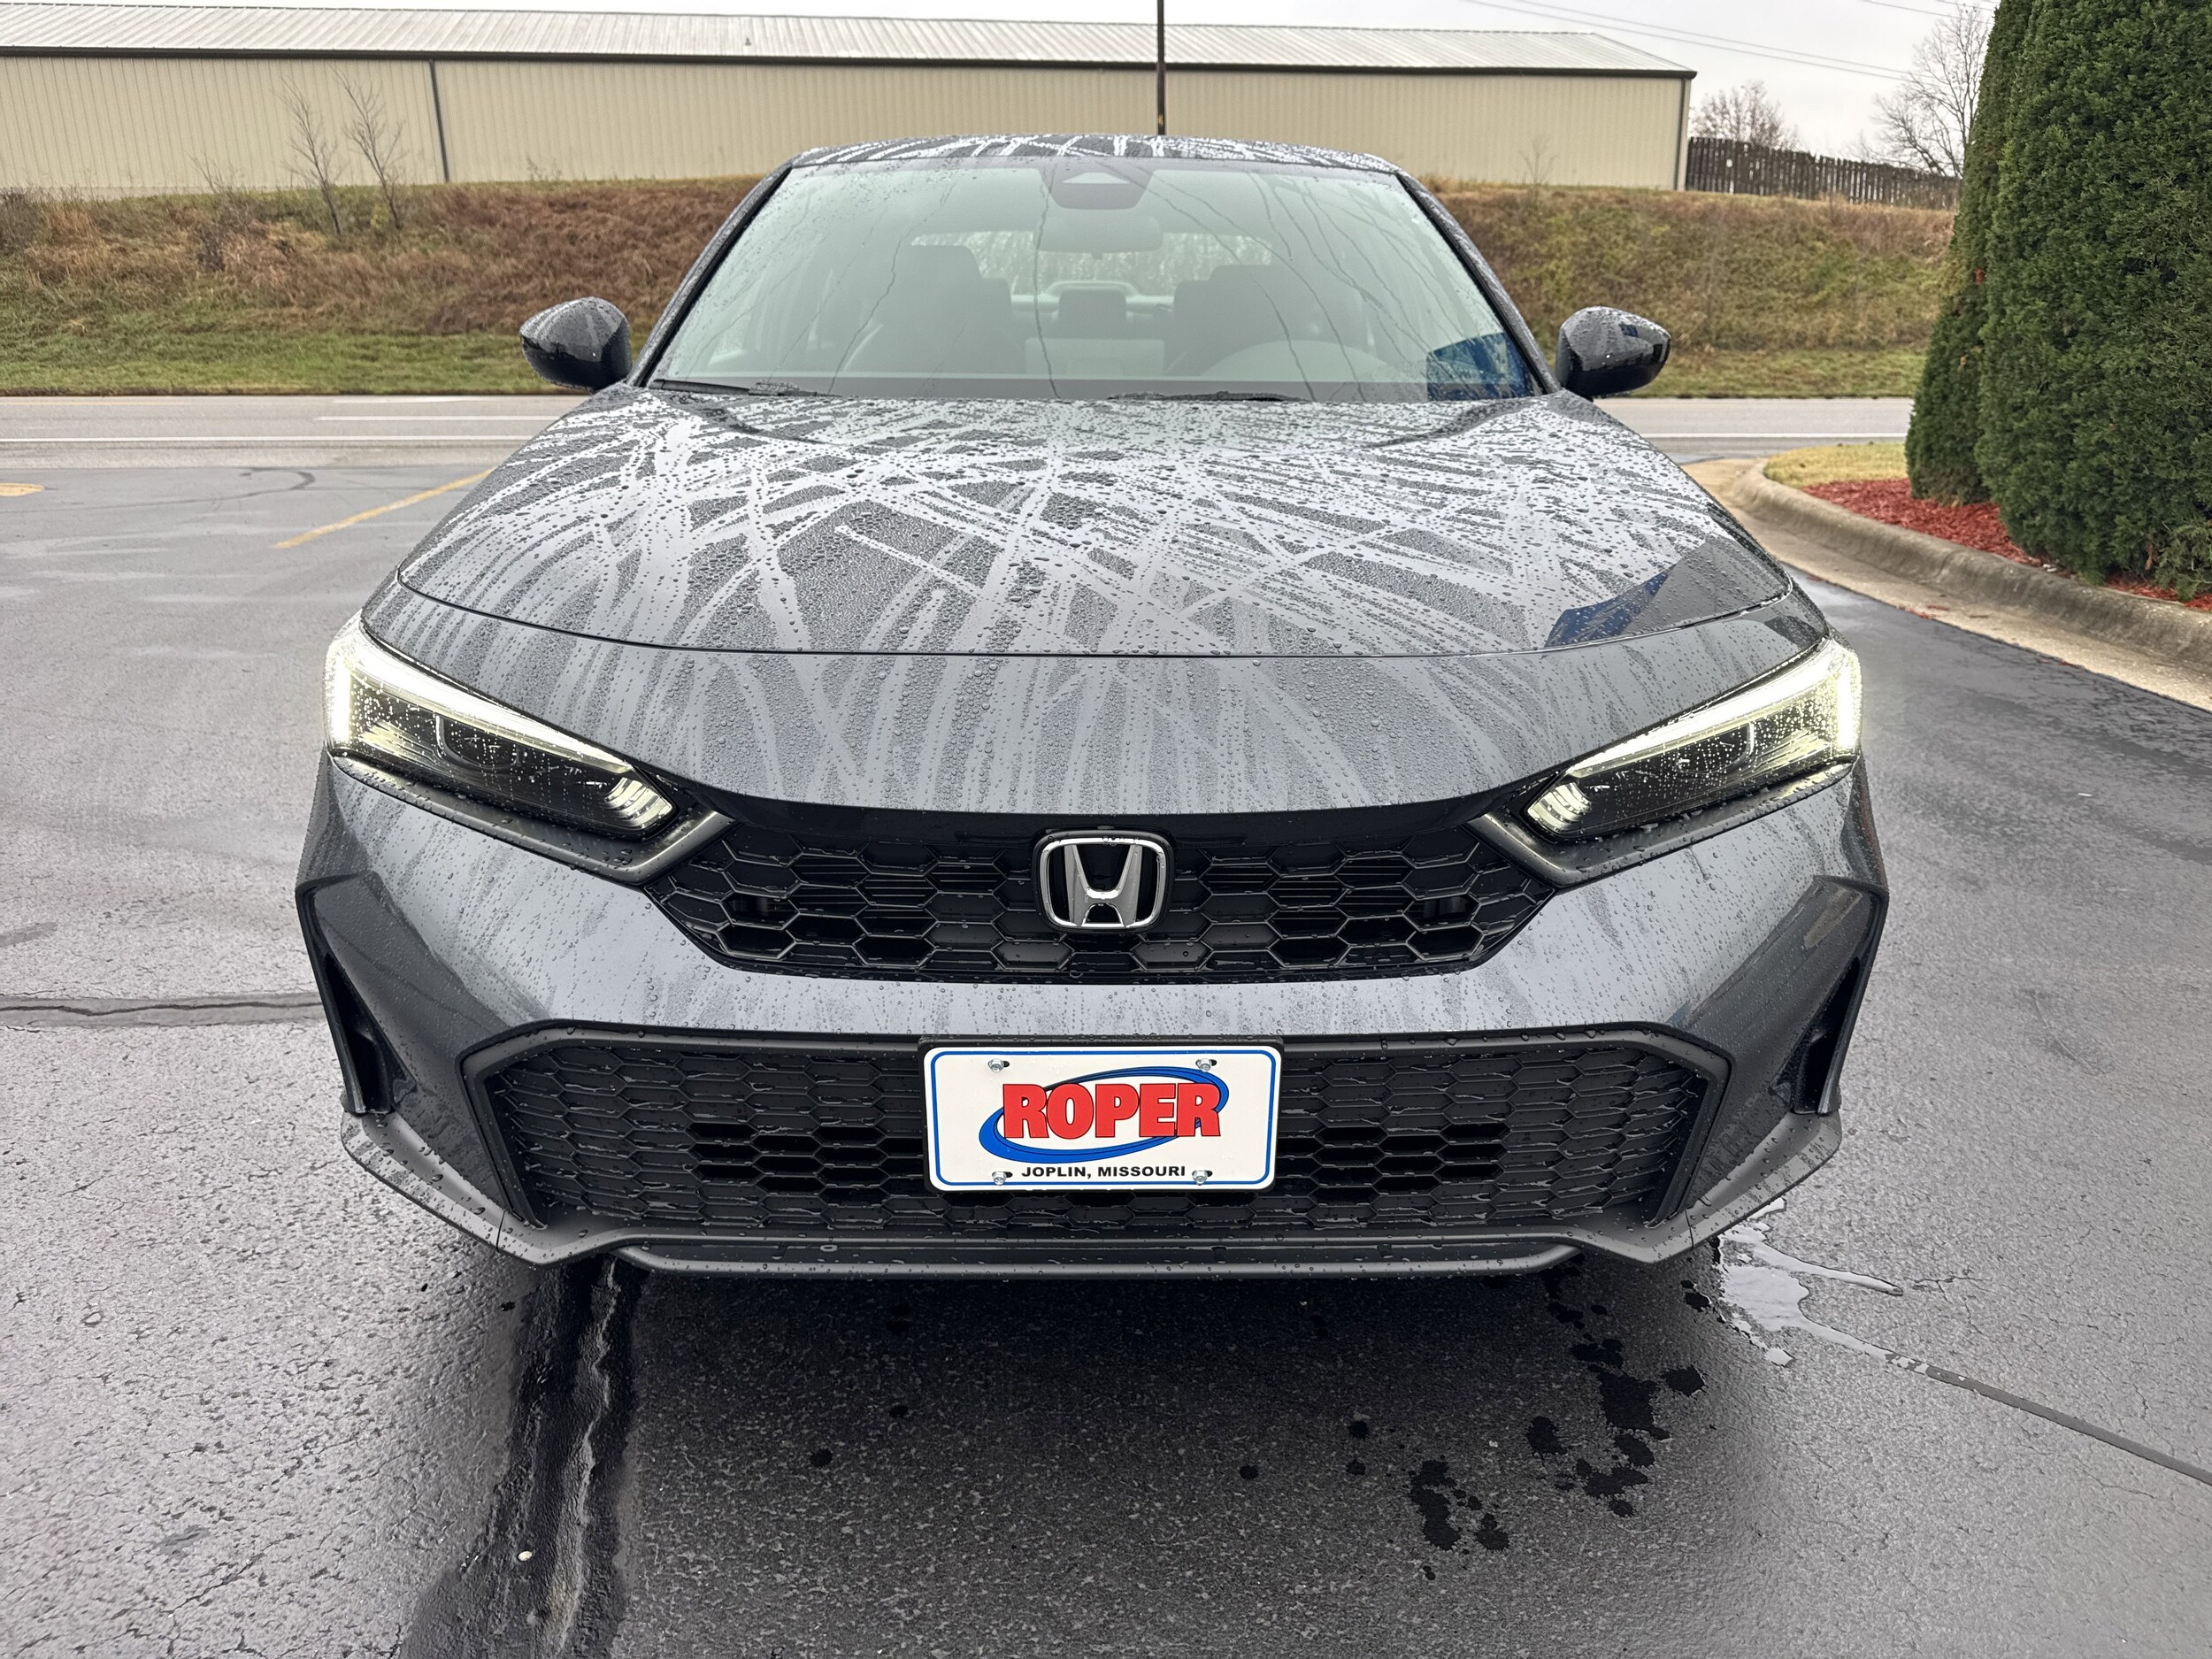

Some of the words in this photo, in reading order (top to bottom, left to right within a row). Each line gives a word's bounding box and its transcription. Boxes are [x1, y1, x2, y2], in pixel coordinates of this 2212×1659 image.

[1002, 1083, 1221, 1140] ROPER
[1021, 1165, 1092, 1179] JOPLIN,
[1097, 1165, 1187, 1178] MISSOURI
